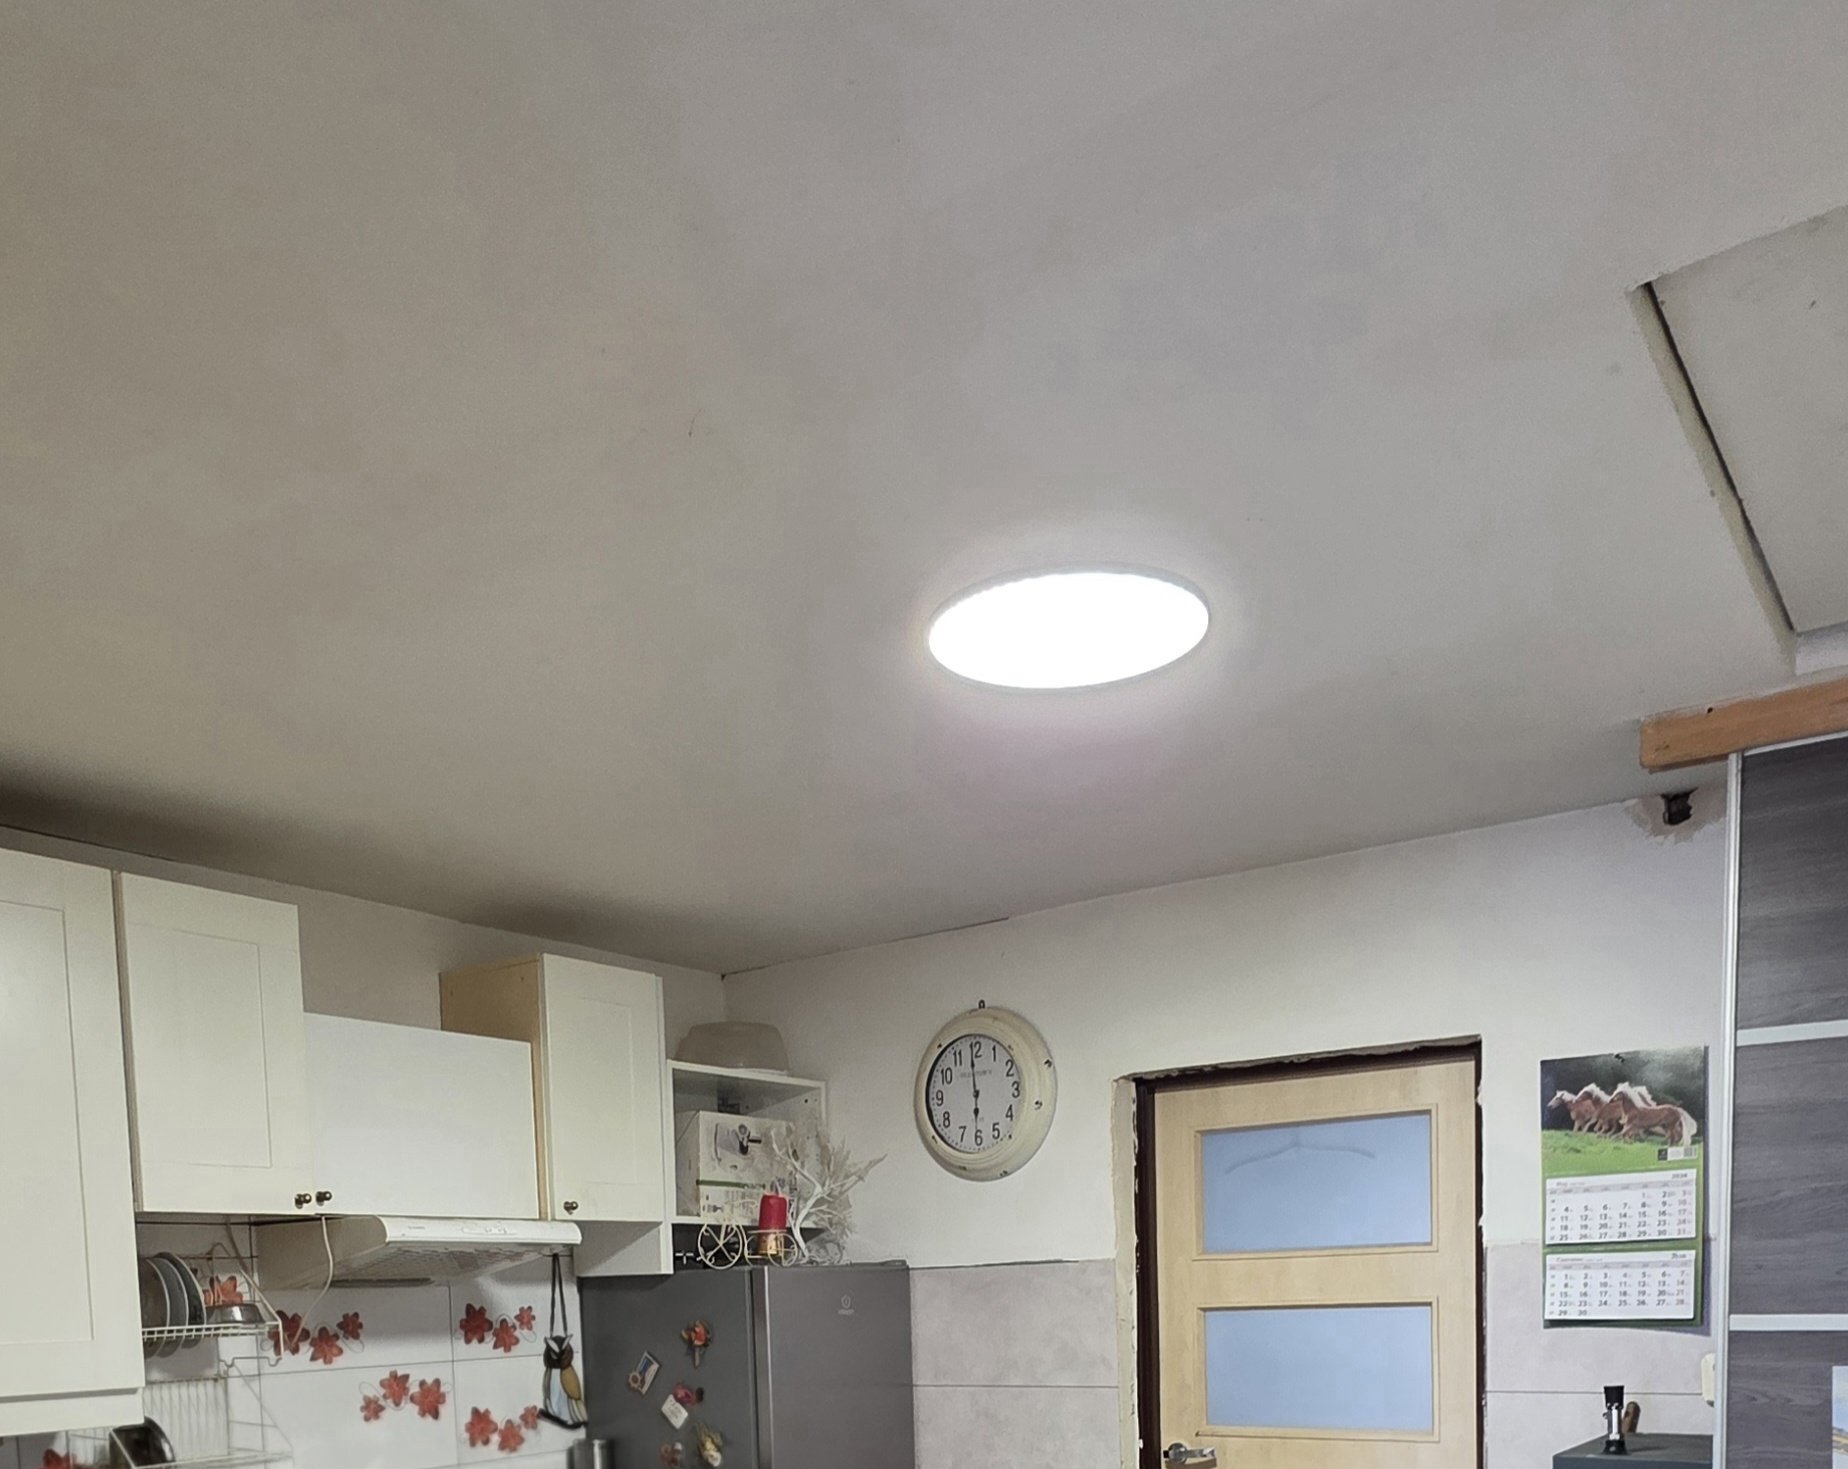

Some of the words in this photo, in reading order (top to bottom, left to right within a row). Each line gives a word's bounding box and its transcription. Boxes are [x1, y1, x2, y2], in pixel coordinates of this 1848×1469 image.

[953, 1049, 963, 1067] 11
[968, 1041, 982, 1059] 12
[992, 1045, 997, 1063] 1
[940, 1067, 953, 1085] 10
[1005, 1059, 1015, 1077] 2
[935, 1090, 944, 1107] 9
[1011, 1080, 1020, 1099] 3
[942, 1111, 951, 1129] 8
[1005, 1104, 1014, 1122] 4
[958, 1126, 967, 1143] 7
[974, 1130, 983, 1147] 6
[992, 1123, 1000, 1140] 5
